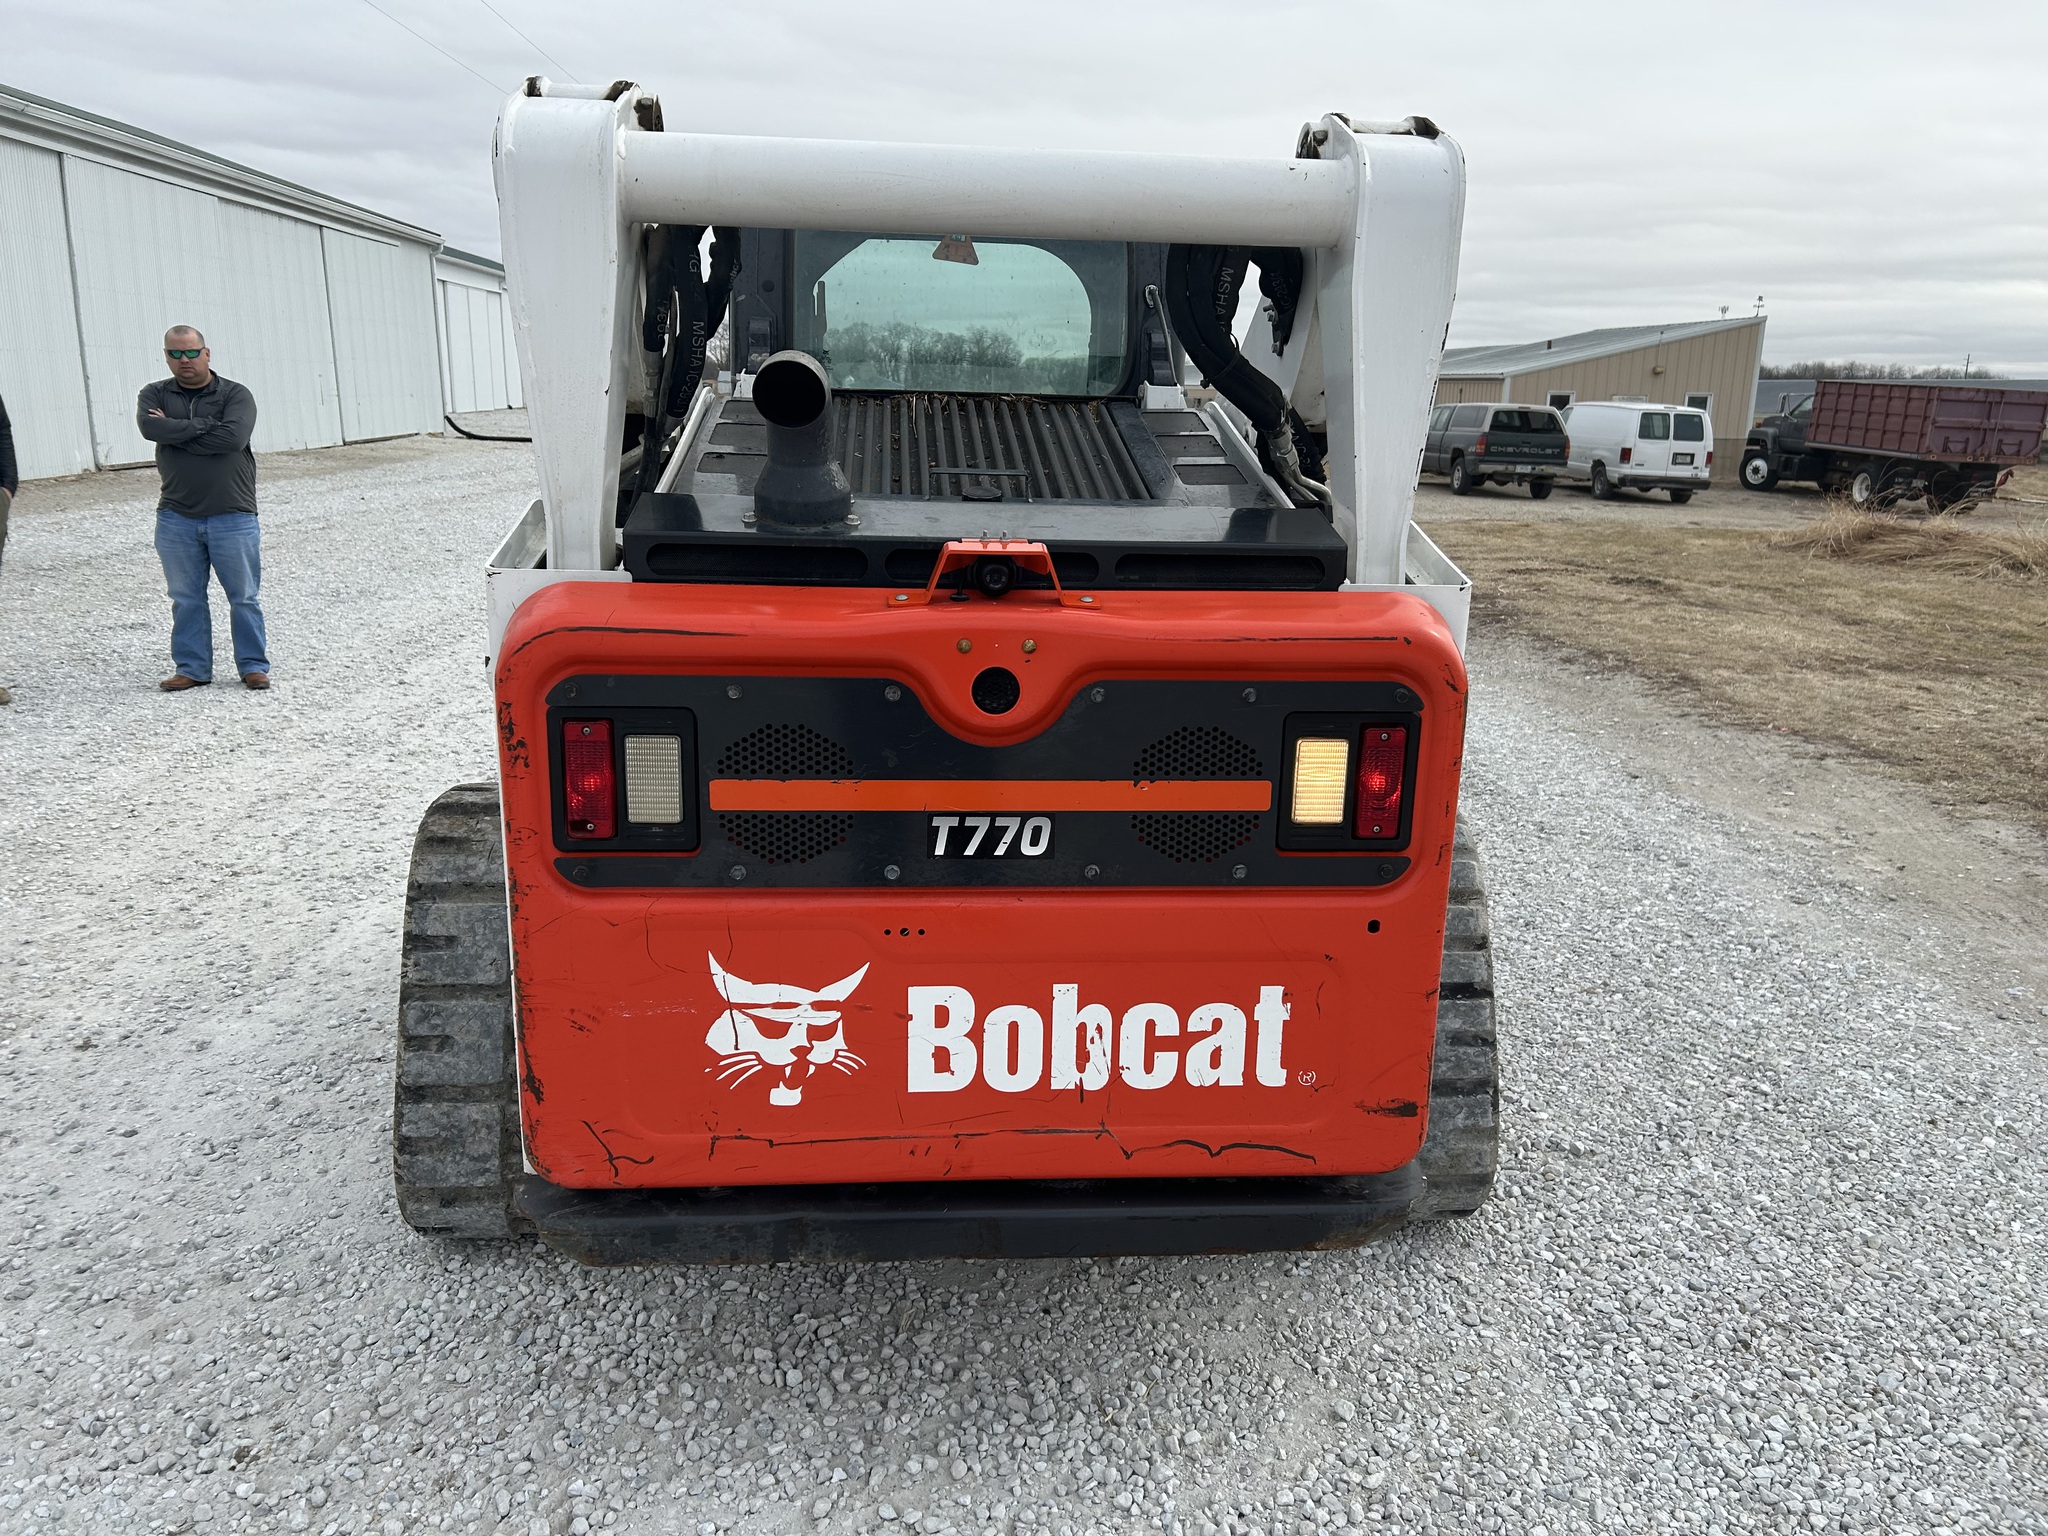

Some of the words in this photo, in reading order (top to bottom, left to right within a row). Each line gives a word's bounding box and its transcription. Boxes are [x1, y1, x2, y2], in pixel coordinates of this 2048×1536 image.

[1214, 267, 1235, 315] MSHA
[689, 320, 705, 367] MSHA
[1490, 445, 1560, 455] CHEVROLET
[931, 816, 1053, 857] T770
[906, 983, 1293, 1094] Bobcat
